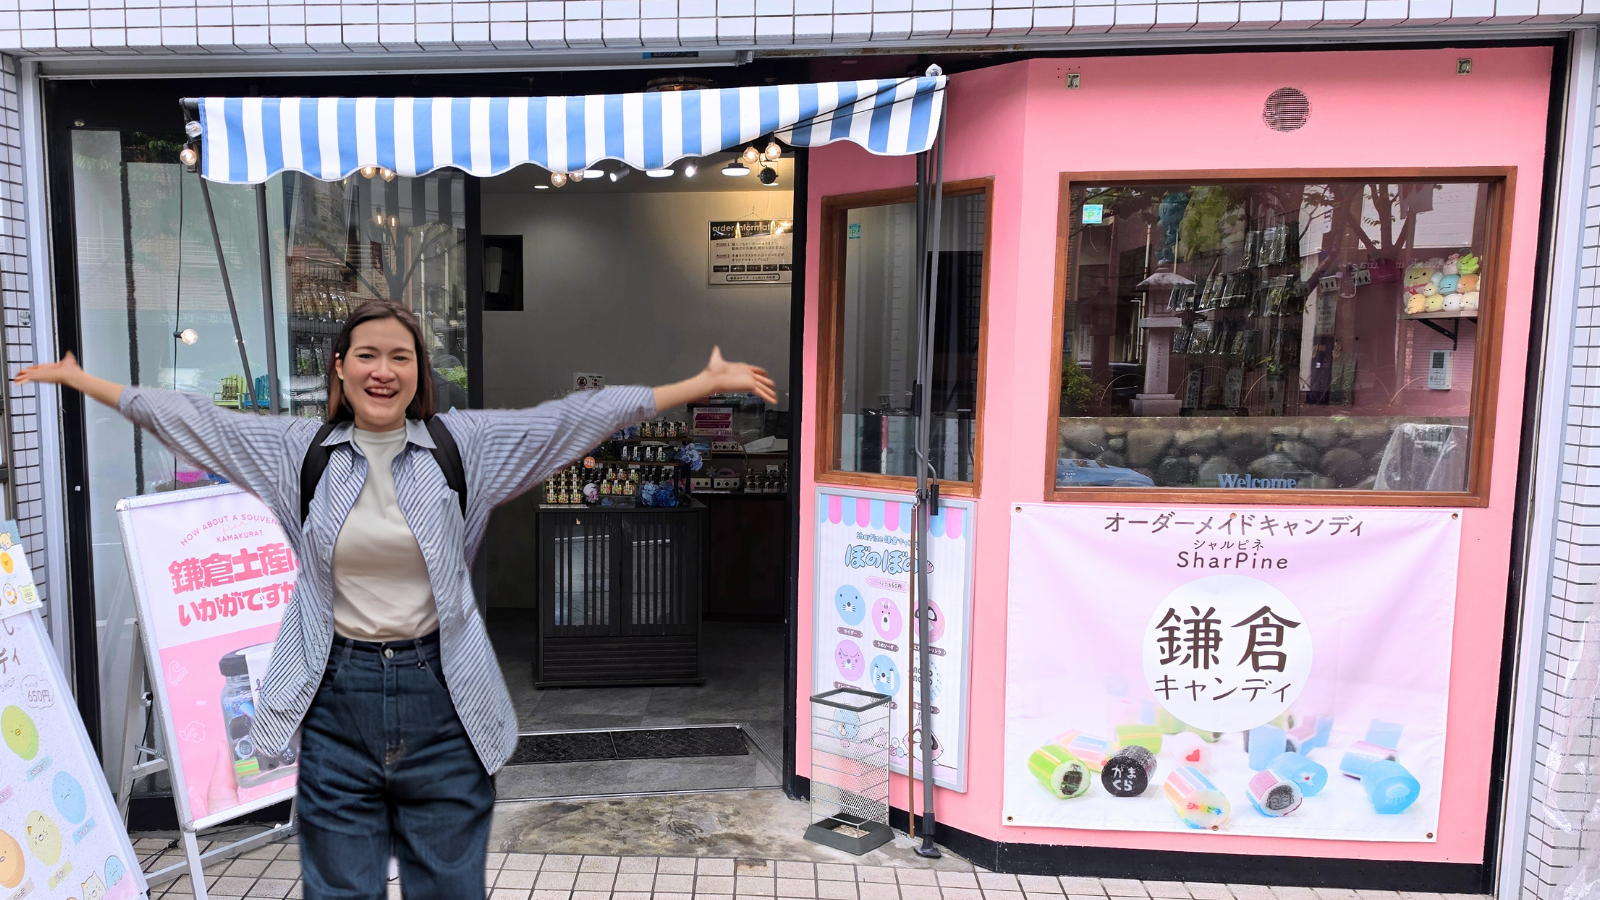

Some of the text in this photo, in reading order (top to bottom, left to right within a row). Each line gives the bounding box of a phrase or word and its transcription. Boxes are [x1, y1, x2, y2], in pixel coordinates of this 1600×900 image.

[1217, 473, 1297, 488] Welcome
[180, 528, 200, 546] HOW
[202, 515, 228, 530] ABOUT
[241, 513, 279, 526] SOUVEN
[1104, 511, 1363, 536] オーダーメイドキャンディ
[216, 529, 263, 543] KAMAKURA?
[1194, 538, 1264, 551] シャルピネ
[1176, 551, 1288, 569] SharPine
[1155, 605, 1301, 672] 鎌倉
[28, 689, 51, 702] 650円
[1155, 674, 1291, 702] キャンディ
